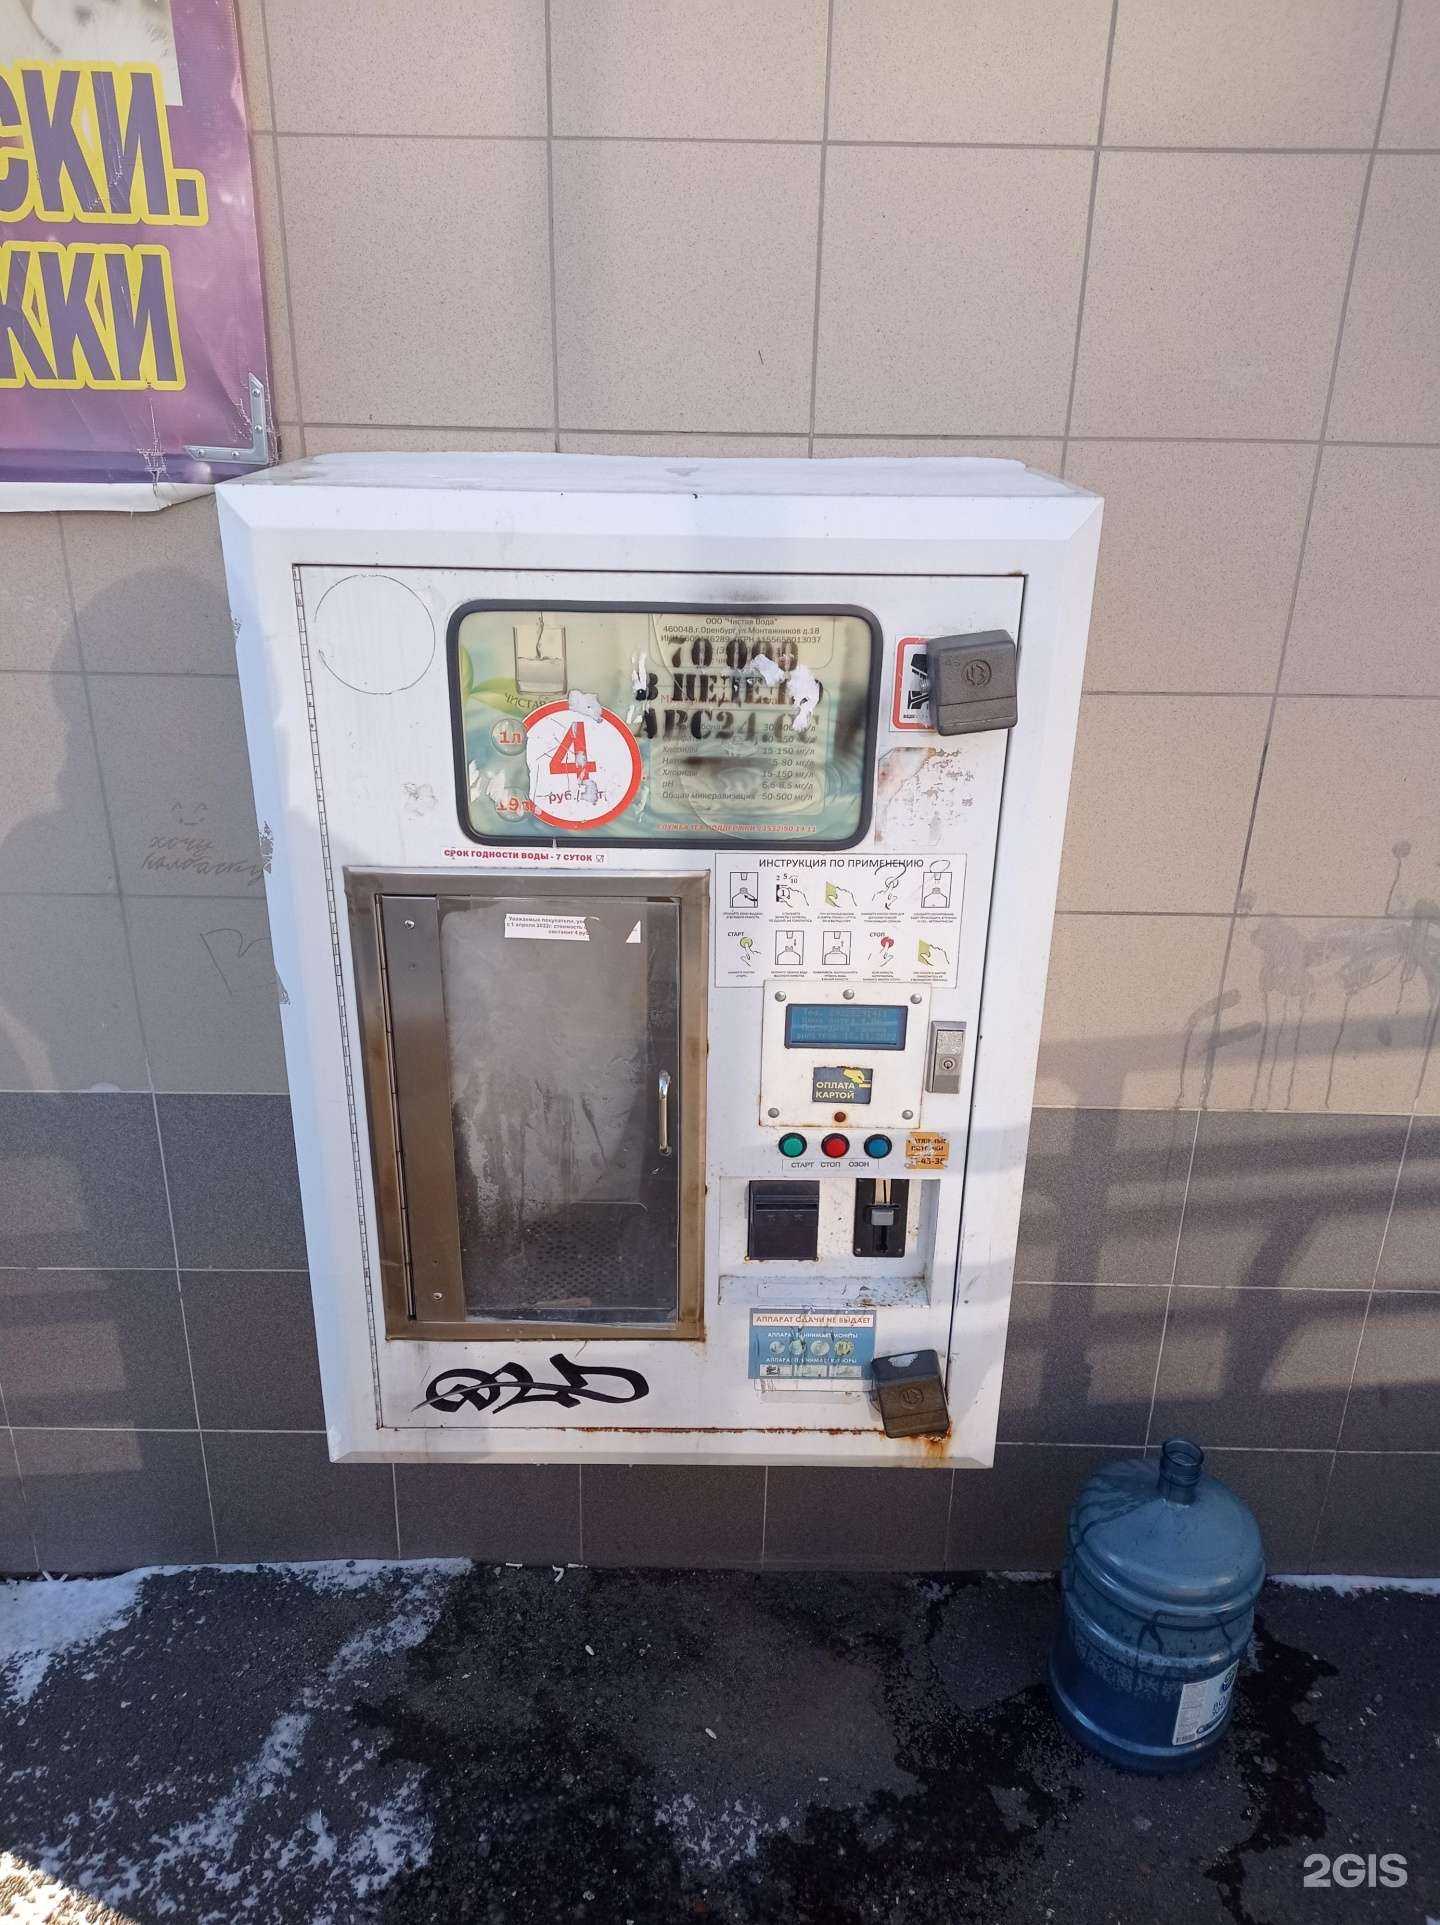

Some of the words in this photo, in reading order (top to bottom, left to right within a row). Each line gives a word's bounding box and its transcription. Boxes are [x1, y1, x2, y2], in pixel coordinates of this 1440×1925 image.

[705, 617, 723, 625] ООО
[549, 721, 597, 780] 4
[444, 849, 469, 857] СРОК
[470, 850, 519, 859] ГОДНОСТИ
[521, 852, 549, 860] ВОДЫ
[556, 853, 561, 861] 7
[563, 854, 592, 862] СУТОК
[758, 859, 827, 869] ИНСТРУКЦИЯ
[829, 859, 845, 868] ПО
[847, 859, 924, 868] ПРИМЕНЕНИЮ
[816, 1081, 855, 1089] ОПЛАТА
[815, 1090, 855, 1099] КАРТОЙ
[838, 1316, 871, 1324] ВЫДАЕТ
